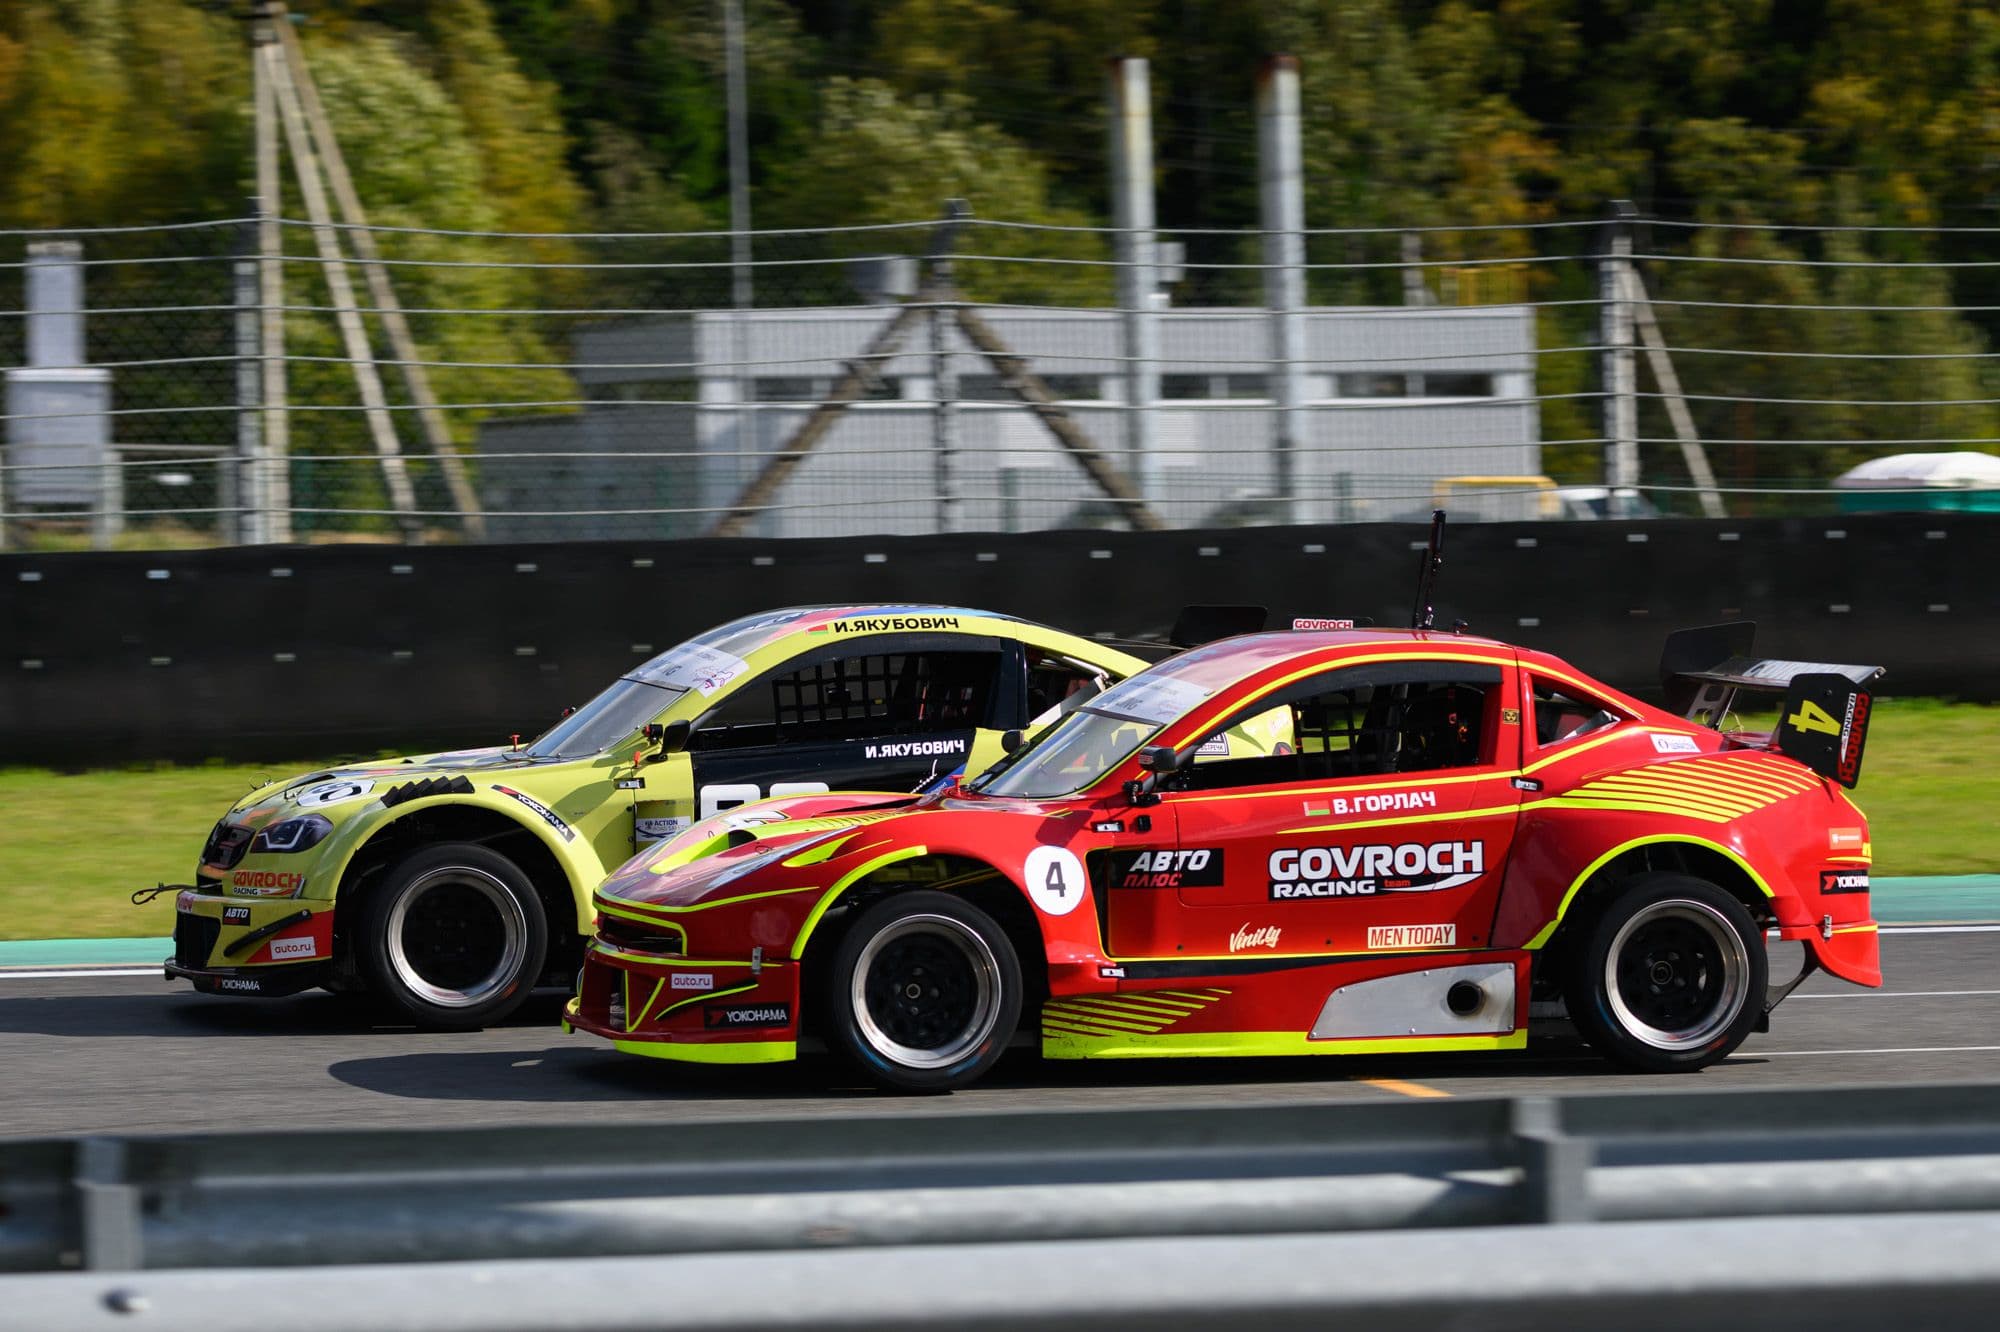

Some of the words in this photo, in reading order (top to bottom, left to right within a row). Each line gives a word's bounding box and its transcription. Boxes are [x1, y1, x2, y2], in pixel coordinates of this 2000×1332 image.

[834, 618, 959, 633] И.ЯКУБОВИЧ
[1294, 620, 1352, 629] GOVROCH
[1788, 700, 1841, 736] 4
[1838, 692, 1870, 782] GOVROCH
[865, 739, 965, 759] И.ЯКУБОВИЧ
[1333, 791, 1436, 815] В.ГОРЛАЧ
[518, 794, 569, 837] YOKOHAMA
[1129, 850, 1211, 872] АВТО
[1269, 841, 1483, 881] GOVROCH
[233, 871, 303, 889] GOVROCH
[1045, 862, 1066, 897] 4
[1123, 873, 1182, 888] ПЛЮС
[1274, 880, 1375, 898] RACING
[1384, 879, 1411, 888] team
[233, 887, 258, 896] RACING
[225, 908, 248, 918] АВТО
[1370, 928, 1403, 946] MEN
[1406, 926, 1453, 945] TODAY
[274, 943, 311, 954] auto.ru
[222, 979, 260, 990] YOKOHAMA
[673, 976, 710, 986] auto.ru
[727, 1009, 787, 1022] YOKOHAMA
